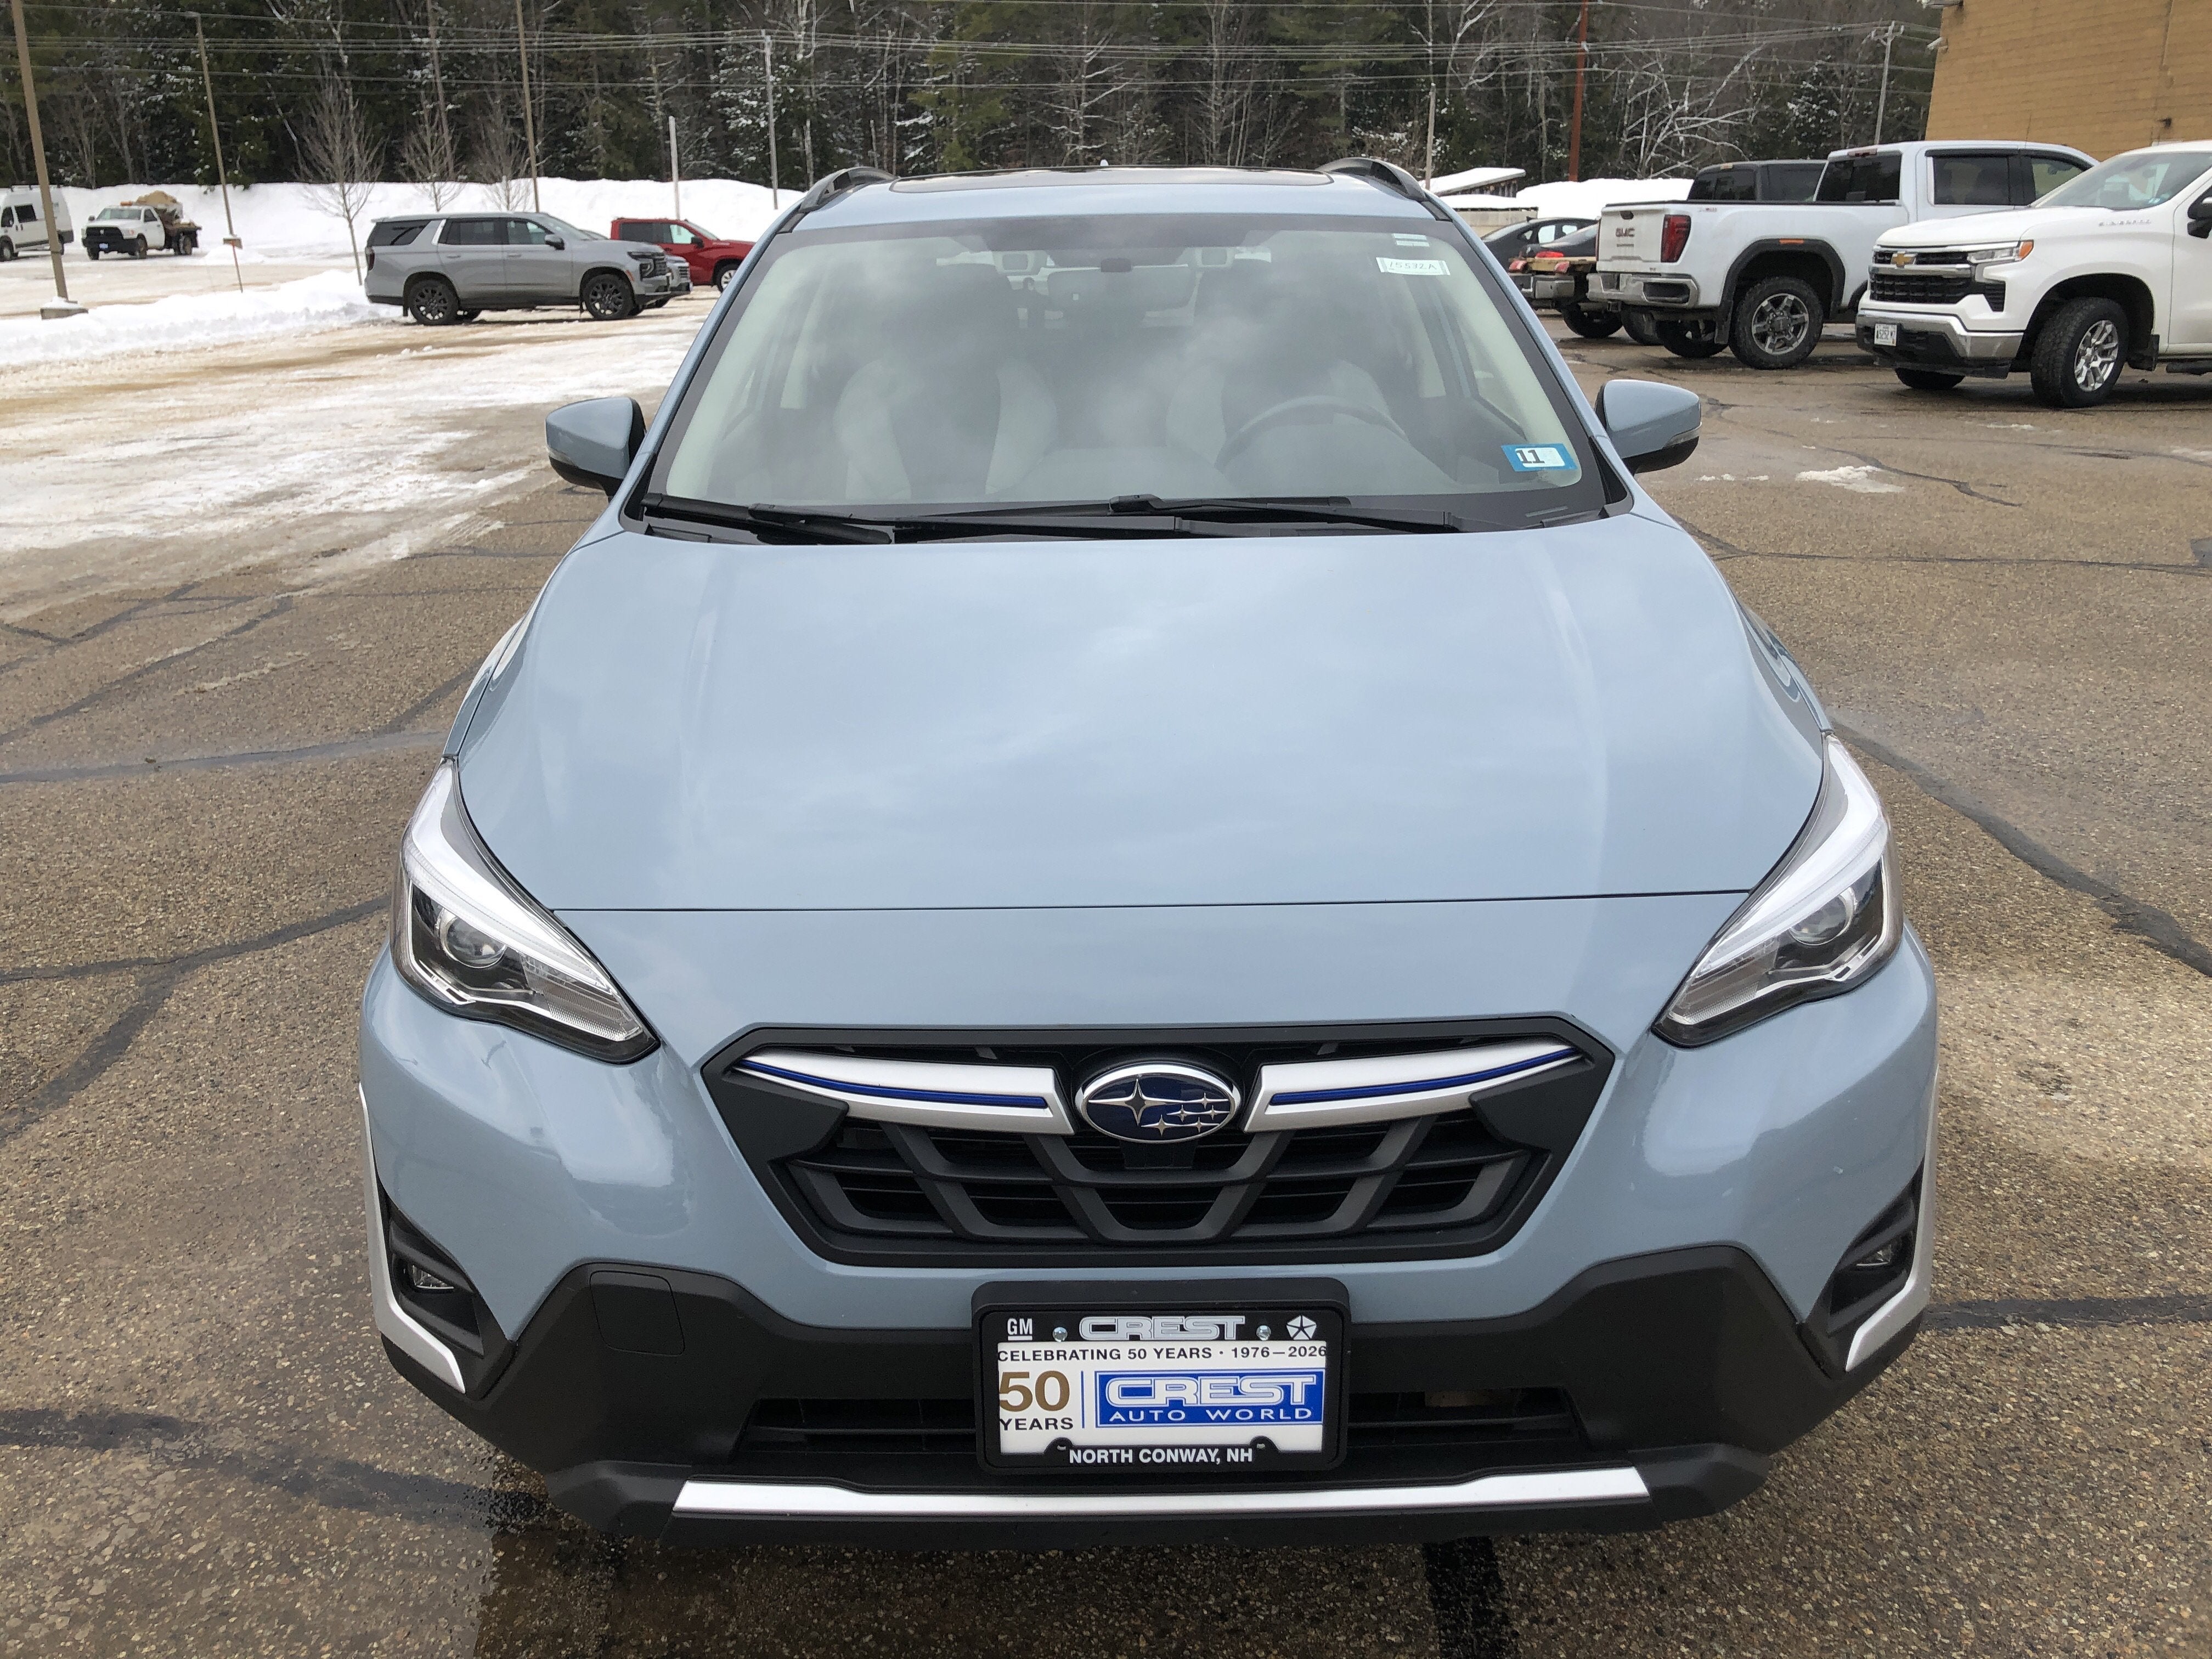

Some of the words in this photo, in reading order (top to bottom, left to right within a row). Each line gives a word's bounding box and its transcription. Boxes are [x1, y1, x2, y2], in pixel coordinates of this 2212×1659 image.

[1516, 449, 1545, 464] 11
[1007, 1318, 1033, 1335] GM
[1079, 1316, 1245, 1340] CREST
[998, 1348, 1121, 1362] CELEBRATING
[1127, 1348, 1147, 1360] 50
[1153, 1347, 1212, 1359] YEARS
[999, 1370, 1070, 1412] 50
[1105, 1374, 1317, 1408] CREST
[1109, 1409, 1186, 1422] AUTO
[1205, 1408, 1312, 1421] WORLD
[1000, 1417, 1074, 1431] YEARS
[1069, 1449, 1133, 1464] NORTH
[1139, 1448, 1221, 1465] CONWAY,
[1227, 1447, 1252, 1463] NH
